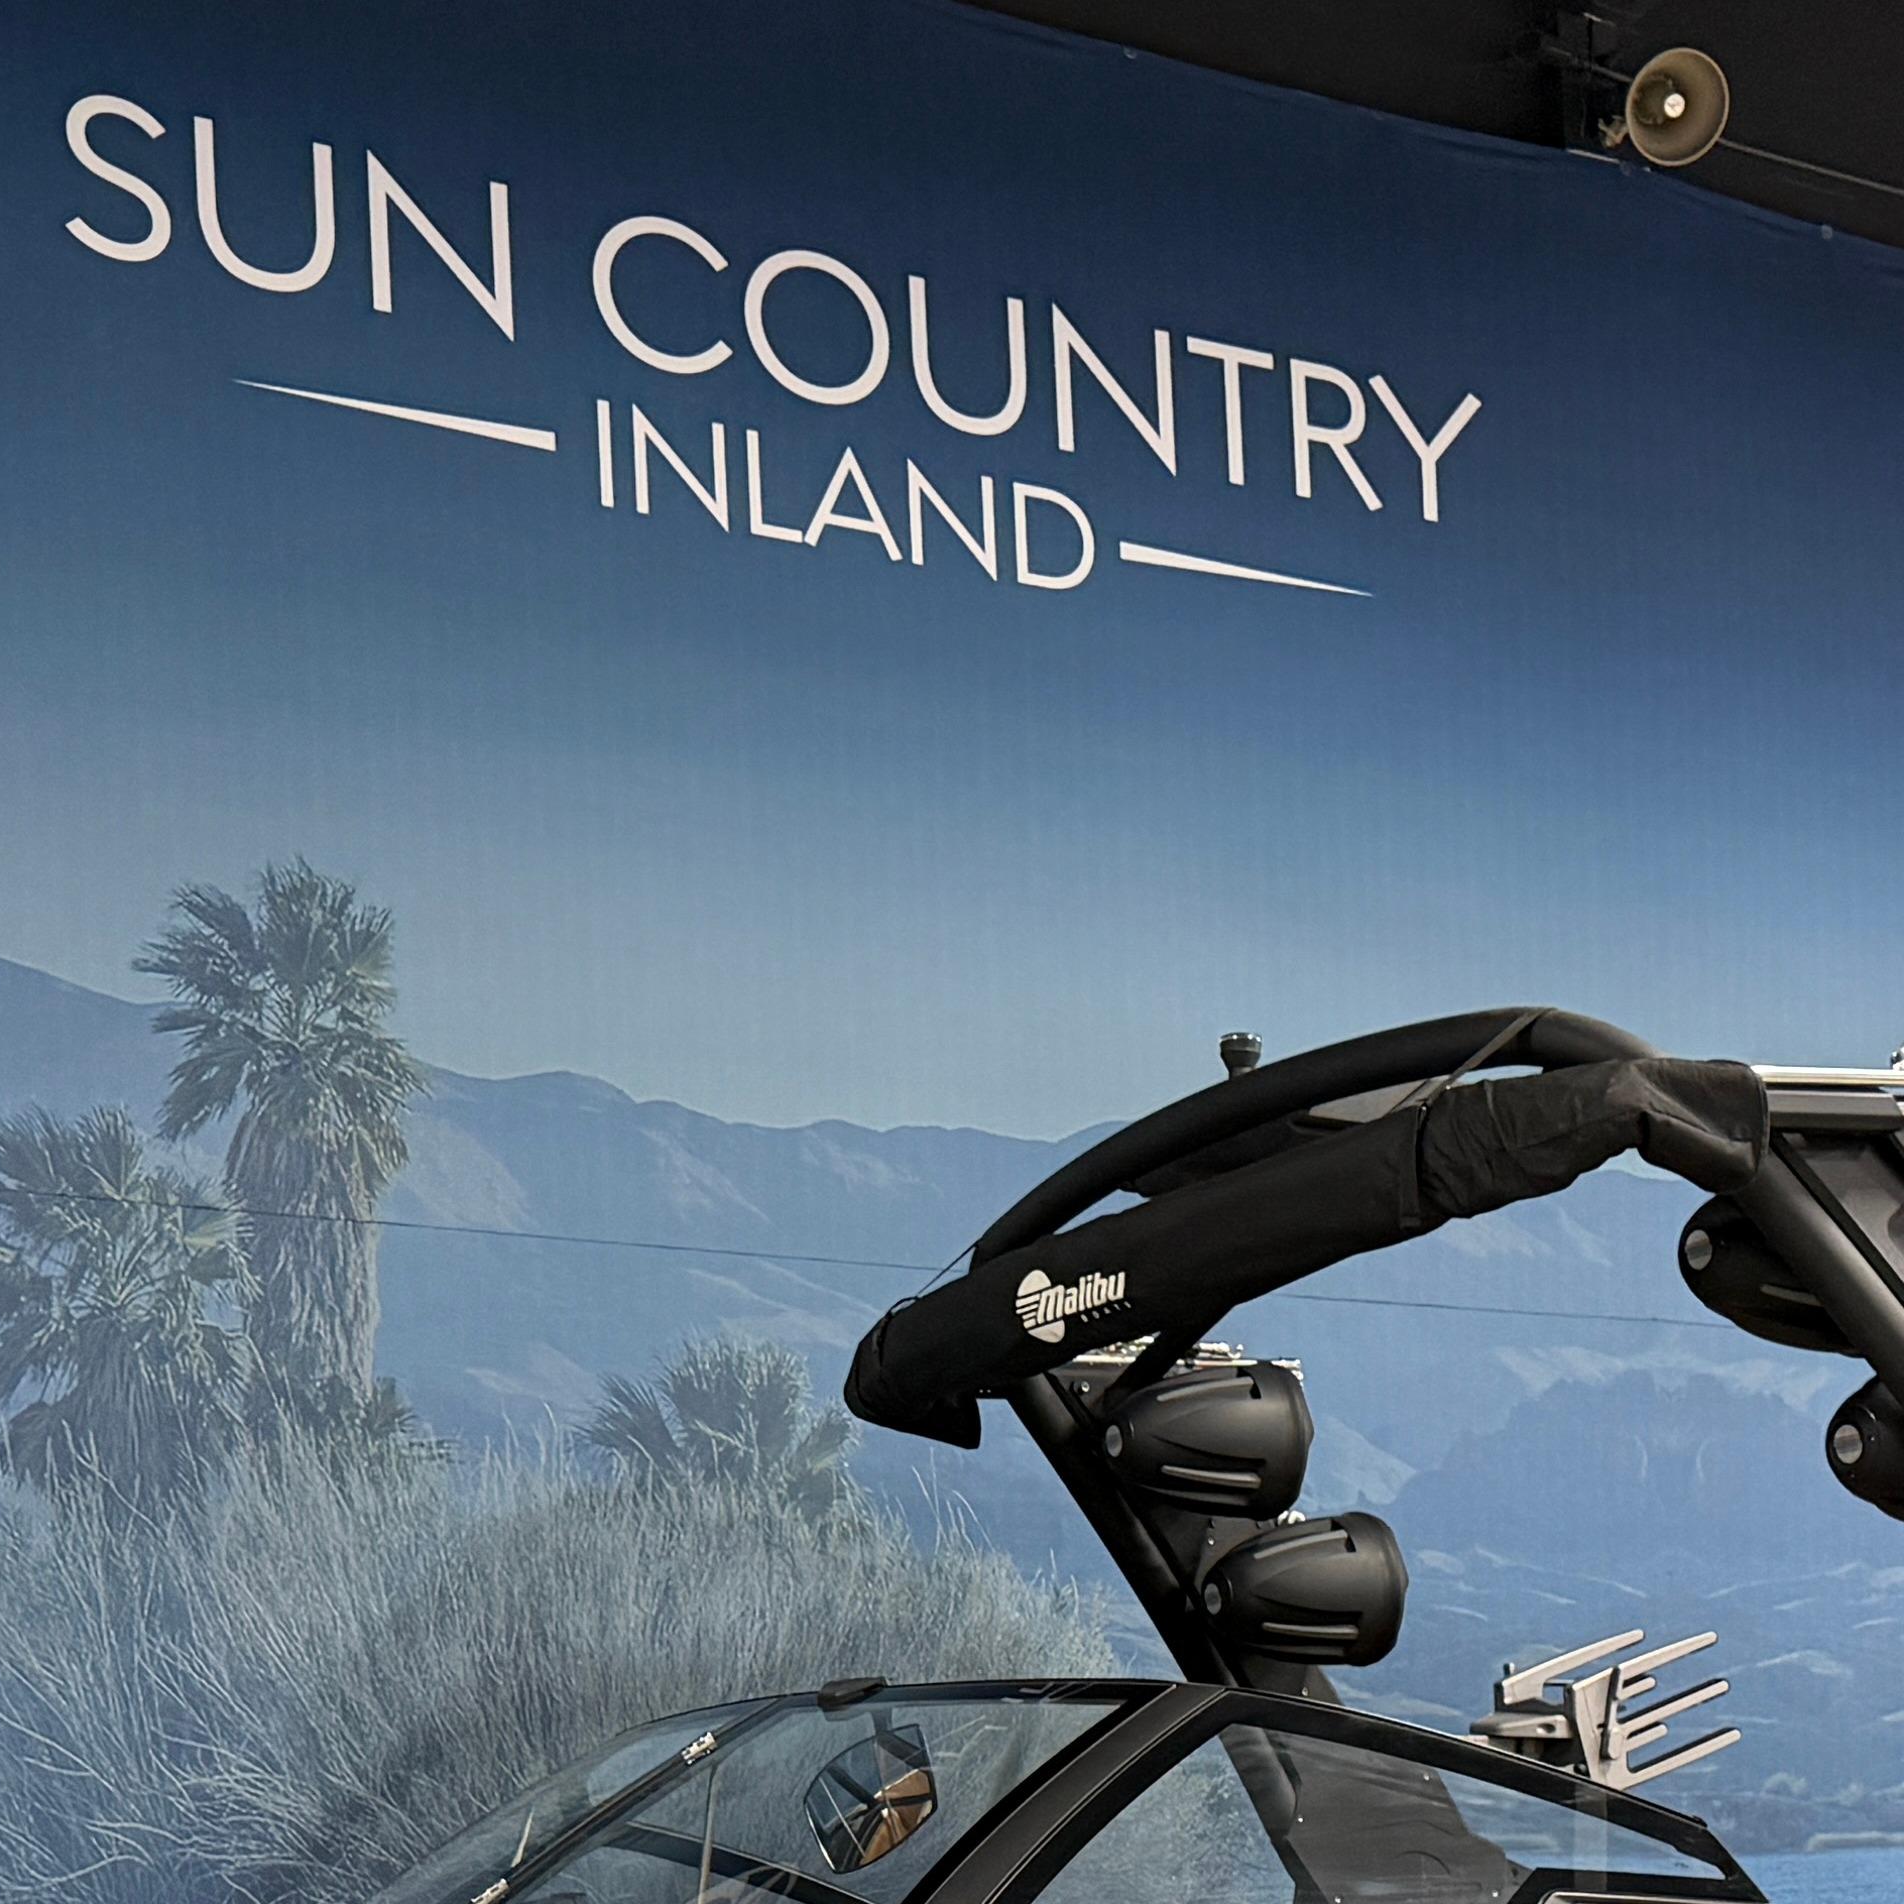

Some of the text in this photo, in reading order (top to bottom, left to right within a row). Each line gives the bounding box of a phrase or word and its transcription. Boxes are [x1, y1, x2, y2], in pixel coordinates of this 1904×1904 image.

[66, 96, 1482, 522] SUN COUNTRY
[597, 400, 1095, 590] INLAND
[1037, 1271, 1126, 1325] Malibu
